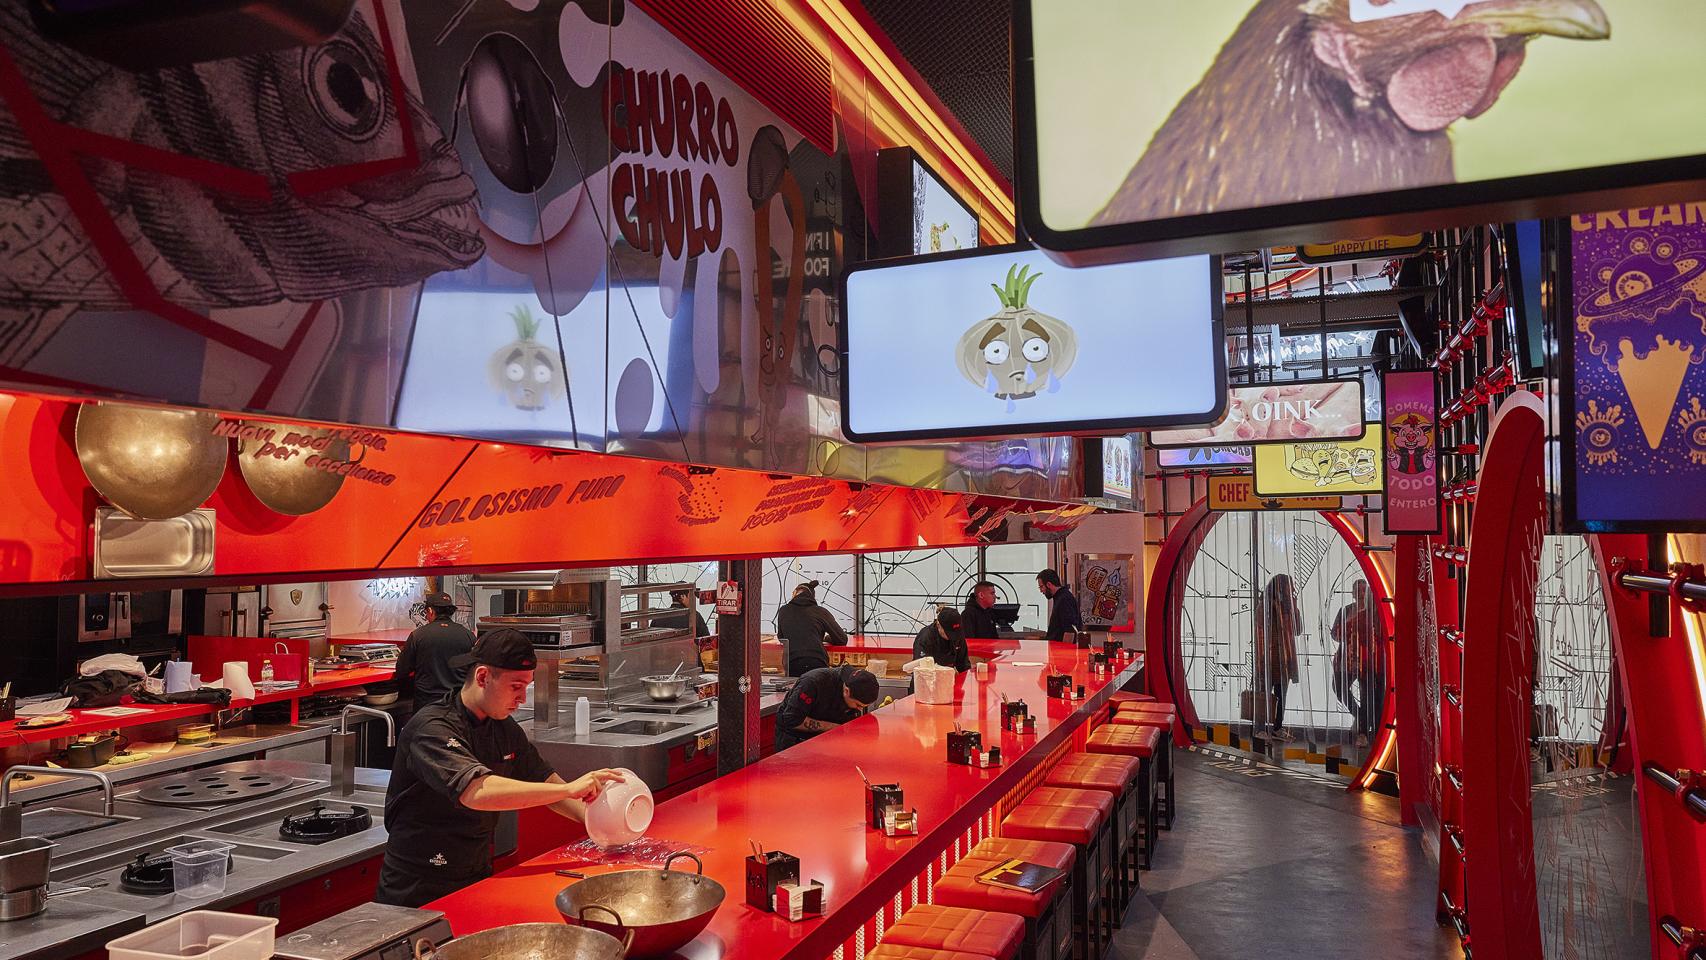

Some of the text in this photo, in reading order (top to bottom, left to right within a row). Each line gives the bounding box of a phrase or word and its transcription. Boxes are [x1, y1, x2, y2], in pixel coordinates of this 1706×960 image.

[602, 68, 739, 167] CHURRO
[612, 163, 723, 261] CHULO
[1333, 239, 1390, 255] HAPPY LIFE
[253, 441, 397, 487] per eccellenza
[1389, 475, 1436, 490] TODO
[418, 483, 563, 529] GOLOSISMO
[566, 474, 626, 505] PURO
[1218, 483, 1249, 503] CHEF
[1389, 497, 1437, 510] ENTERO
[717, 599, 737, 607] TIRAR
